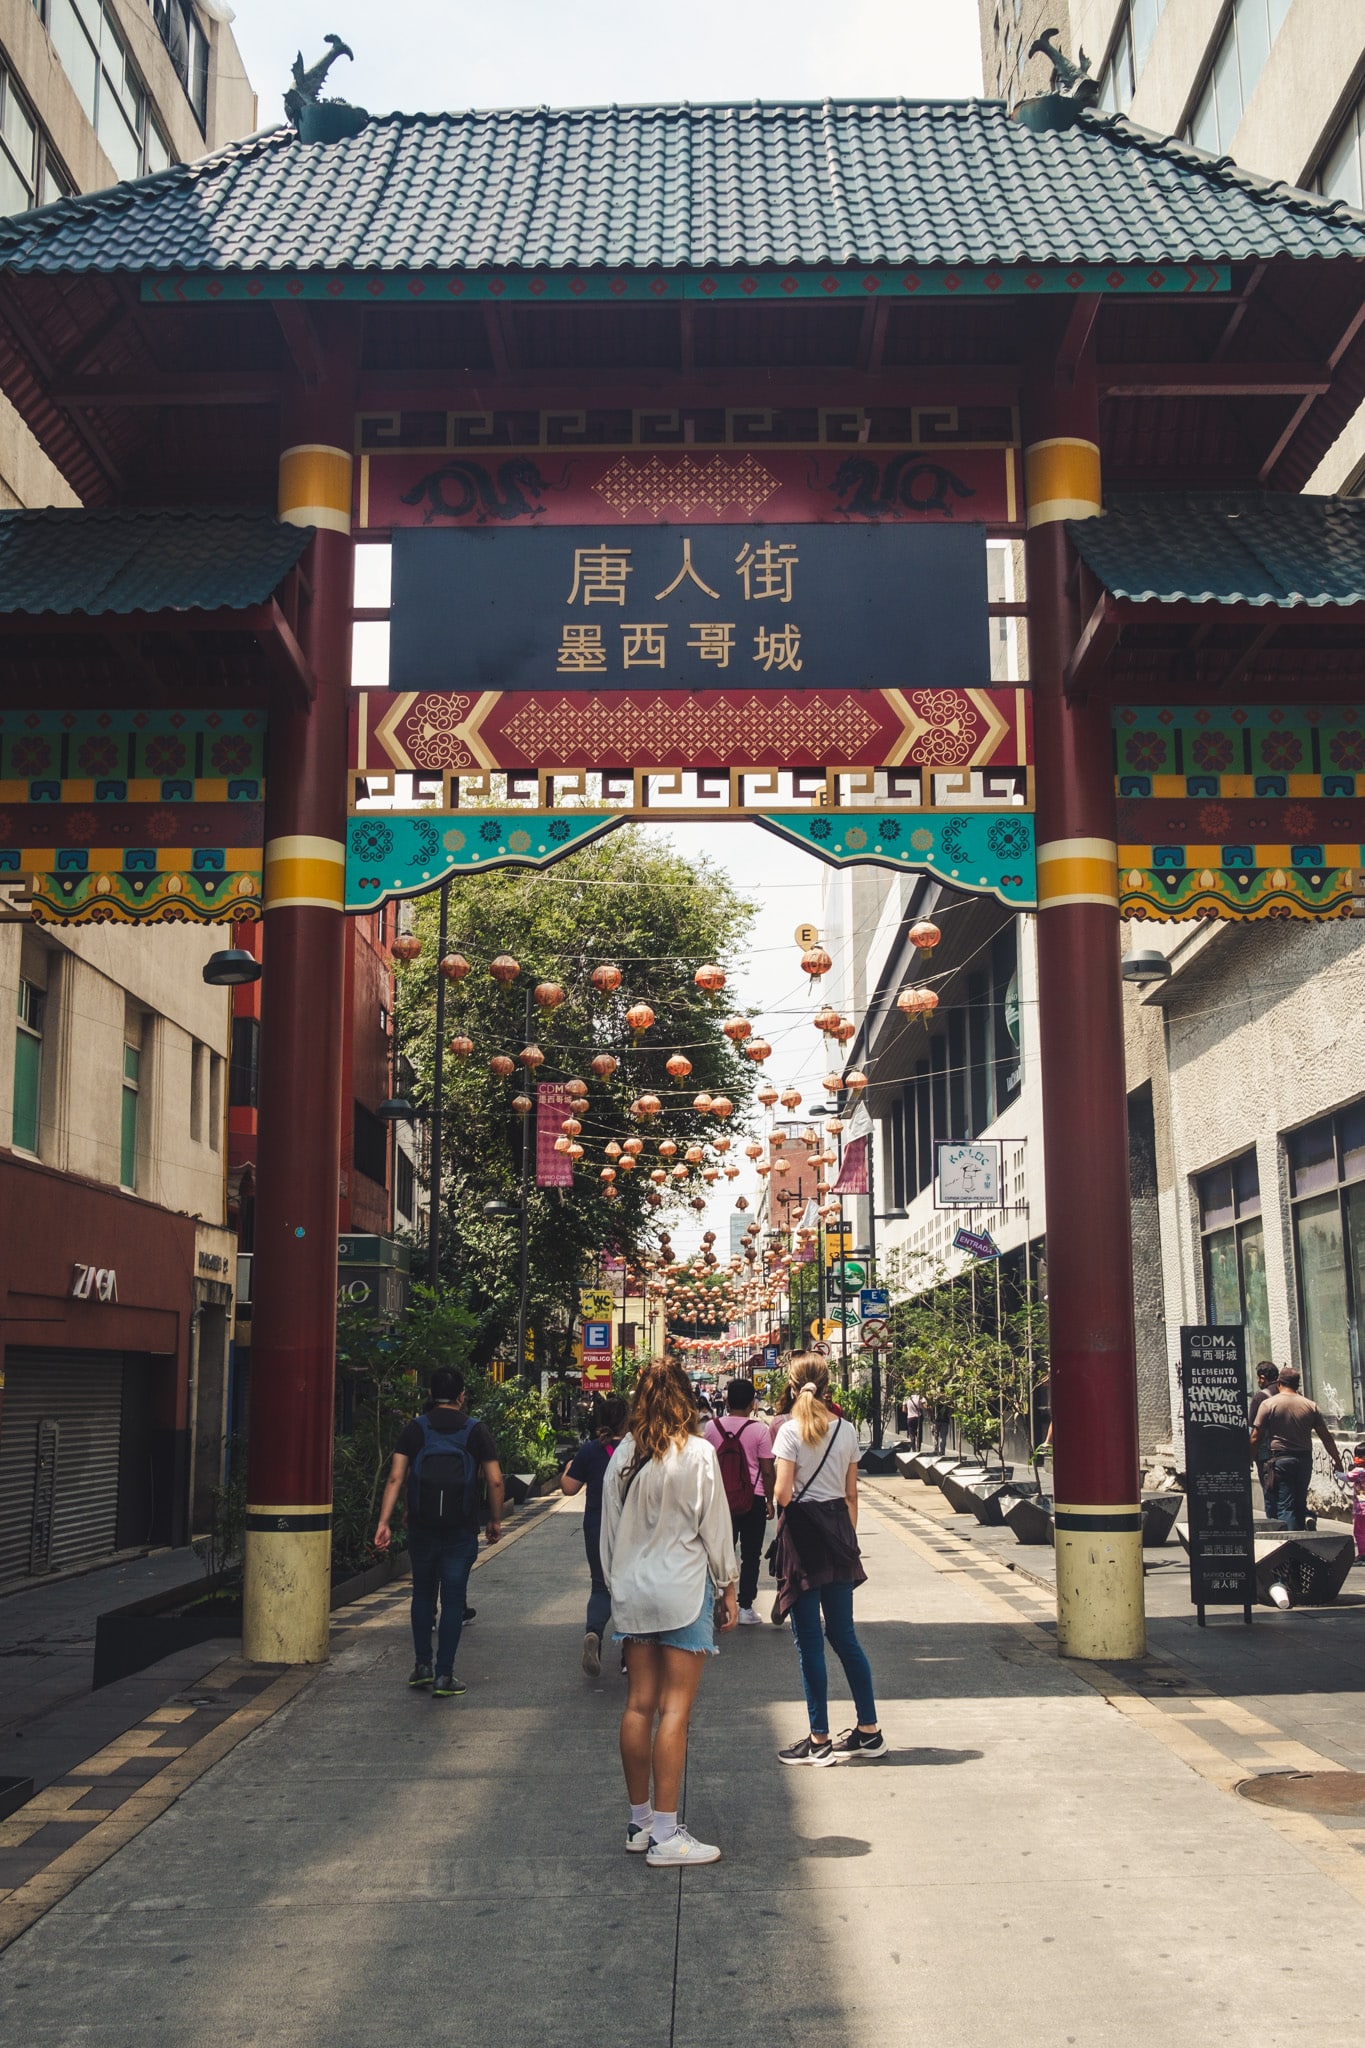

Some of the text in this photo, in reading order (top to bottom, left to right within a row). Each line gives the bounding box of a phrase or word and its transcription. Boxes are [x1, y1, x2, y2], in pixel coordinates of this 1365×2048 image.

[567, 538, 799, 606] 唐人街
[556, 623, 803, 672] 墨西哥城
[802, 929, 811, 941] E
[539, 1084, 566, 1094] CDM
[959, 1235, 993, 1254] ENTRADA
[593, 1295, 611, 1306] WC
[871, 1291, 878, 1299] E
[589, 1326, 605, 1346] E
[766, 1349, 775, 1359] E
[1191, 1368, 1234, 1376] ELEMENTO
